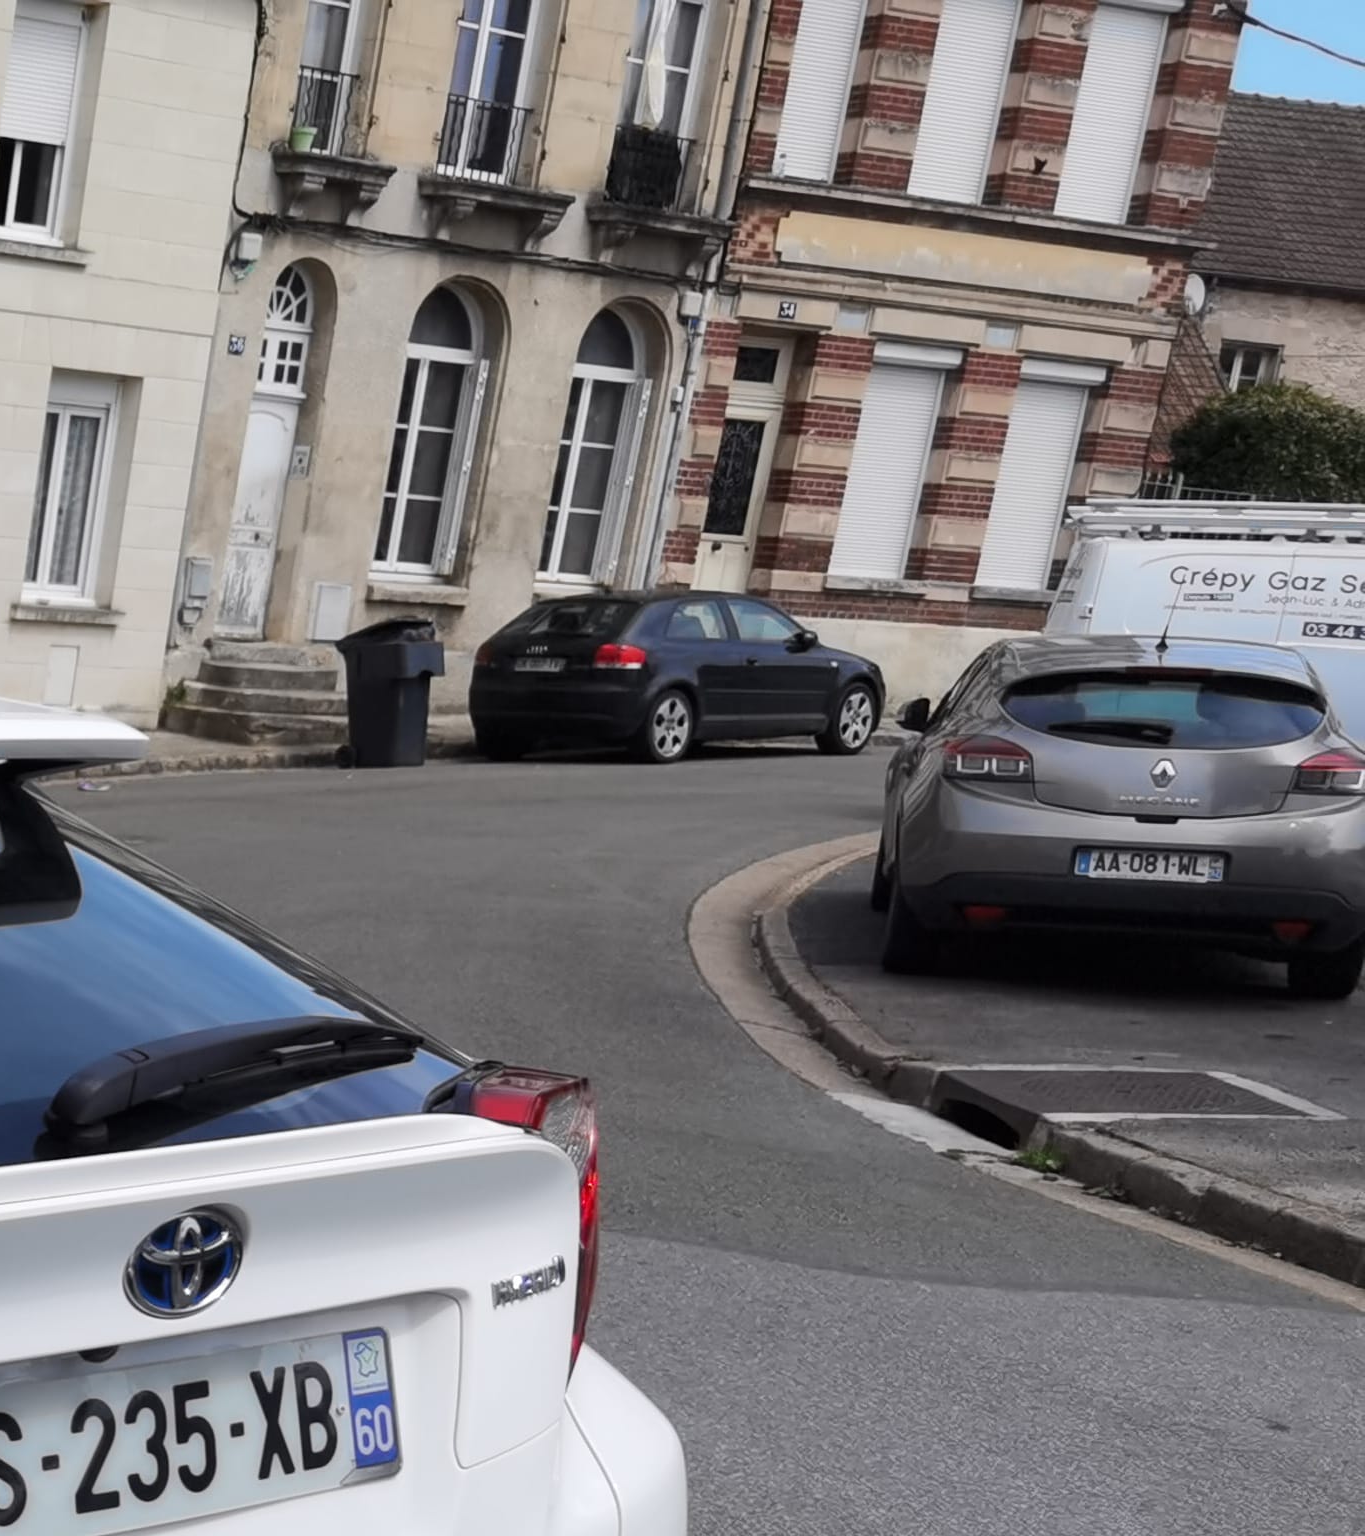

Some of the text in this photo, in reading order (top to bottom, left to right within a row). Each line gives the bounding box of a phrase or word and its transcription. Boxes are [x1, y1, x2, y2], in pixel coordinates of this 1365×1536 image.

[1170, 566, 1256, 593] Crépy
[1268, 571, 1326, 593] Gaz
[1305, 624, 1329, 637] 03
[1332, 625, 1355, 638] 44
[1093, 852, 1207, 878] AA-081-WL
[355, 1404, 395, 1456] 60
